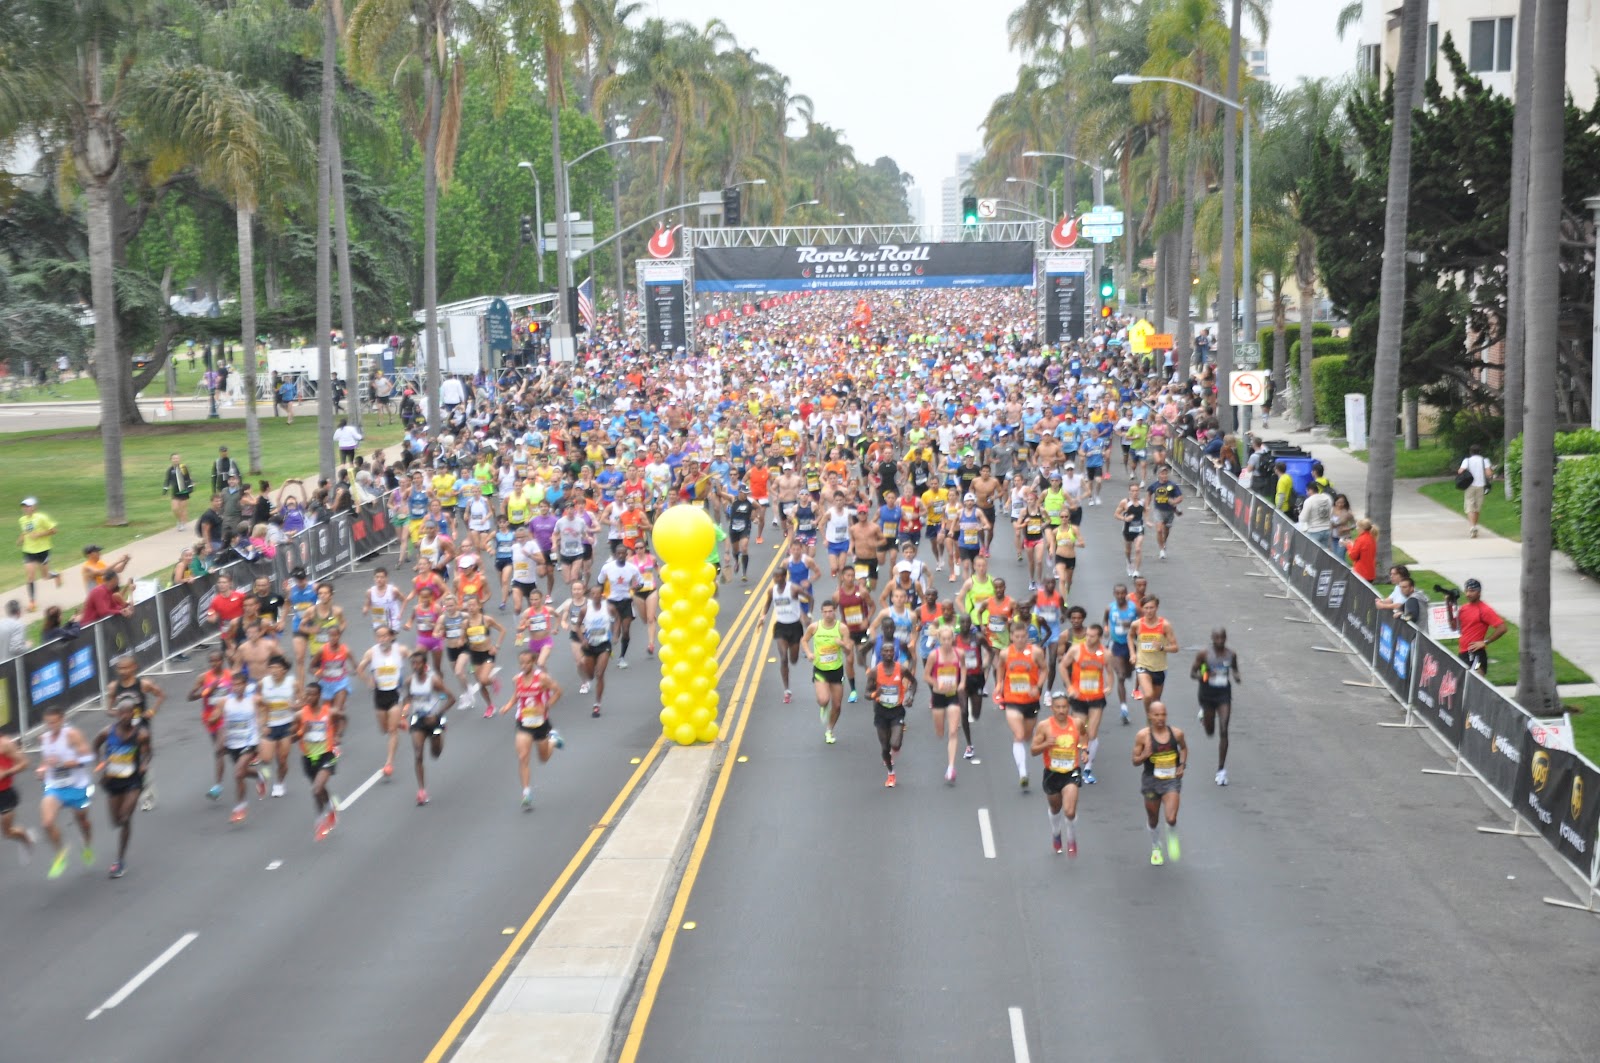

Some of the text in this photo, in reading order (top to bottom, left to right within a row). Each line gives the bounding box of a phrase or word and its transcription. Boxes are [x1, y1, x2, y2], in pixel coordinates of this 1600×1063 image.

[795, 246, 860, 263] Rock
[878, 245, 930, 261] Roll
[815, 263, 912, 273] SAN DIEGO
